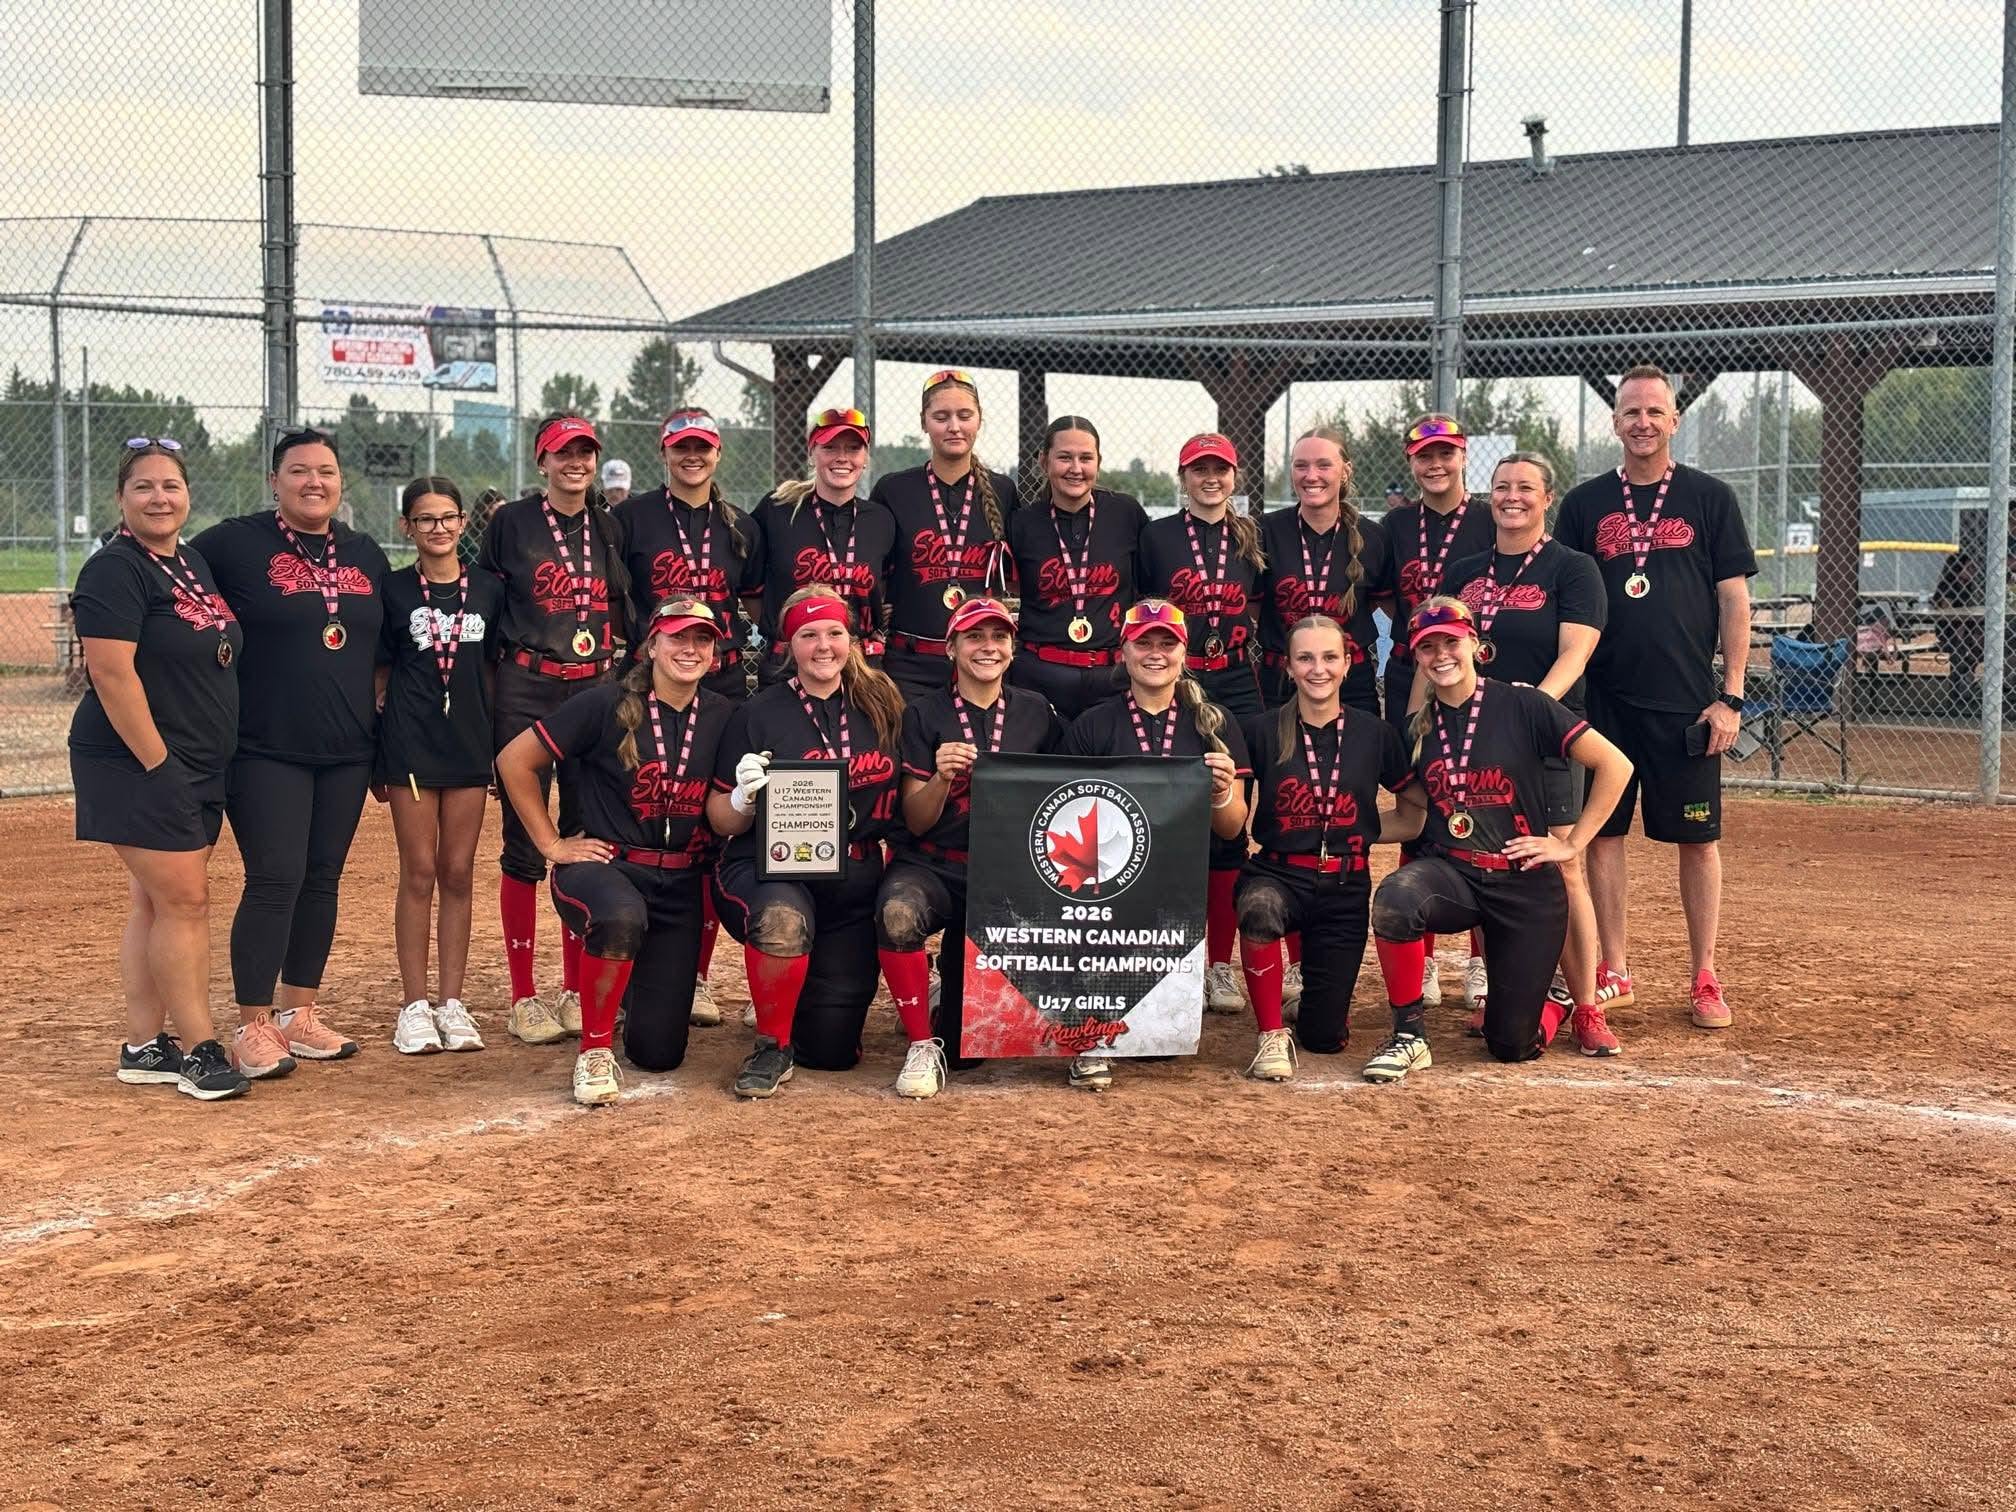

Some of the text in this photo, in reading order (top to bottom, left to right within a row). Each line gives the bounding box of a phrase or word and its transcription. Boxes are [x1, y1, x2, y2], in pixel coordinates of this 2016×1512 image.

[912, 529, 986, 566] Stm
[267, 552, 372, 587] Strm
[533, 559, 609, 599] Stom
[650, 548, 728, 590] Stom
[1039, 557, 1119, 590] Stm
[1458, 577, 1546, 604] Strm
[631, 760, 708, 802] Stm
[1276, 776, 1357, 813] Stom
[1426, 759, 1514, 796] Strm
[771, 821, 835, 829] CHAMPIONS
[1035, 784, 1144, 886] WESTERN CANADA SOFTBALL ASSOCIATION
[1061, 906, 1113, 921] 2026
[985, 927, 1185, 946] WESTERN CANADIAN
[975, 954, 1193, 973] SOFTBALL CHAMPIONS
[1038, 995, 1126, 1011] U17 GIRLS
[1042, 1016, 1130, 1047] Rawlings
